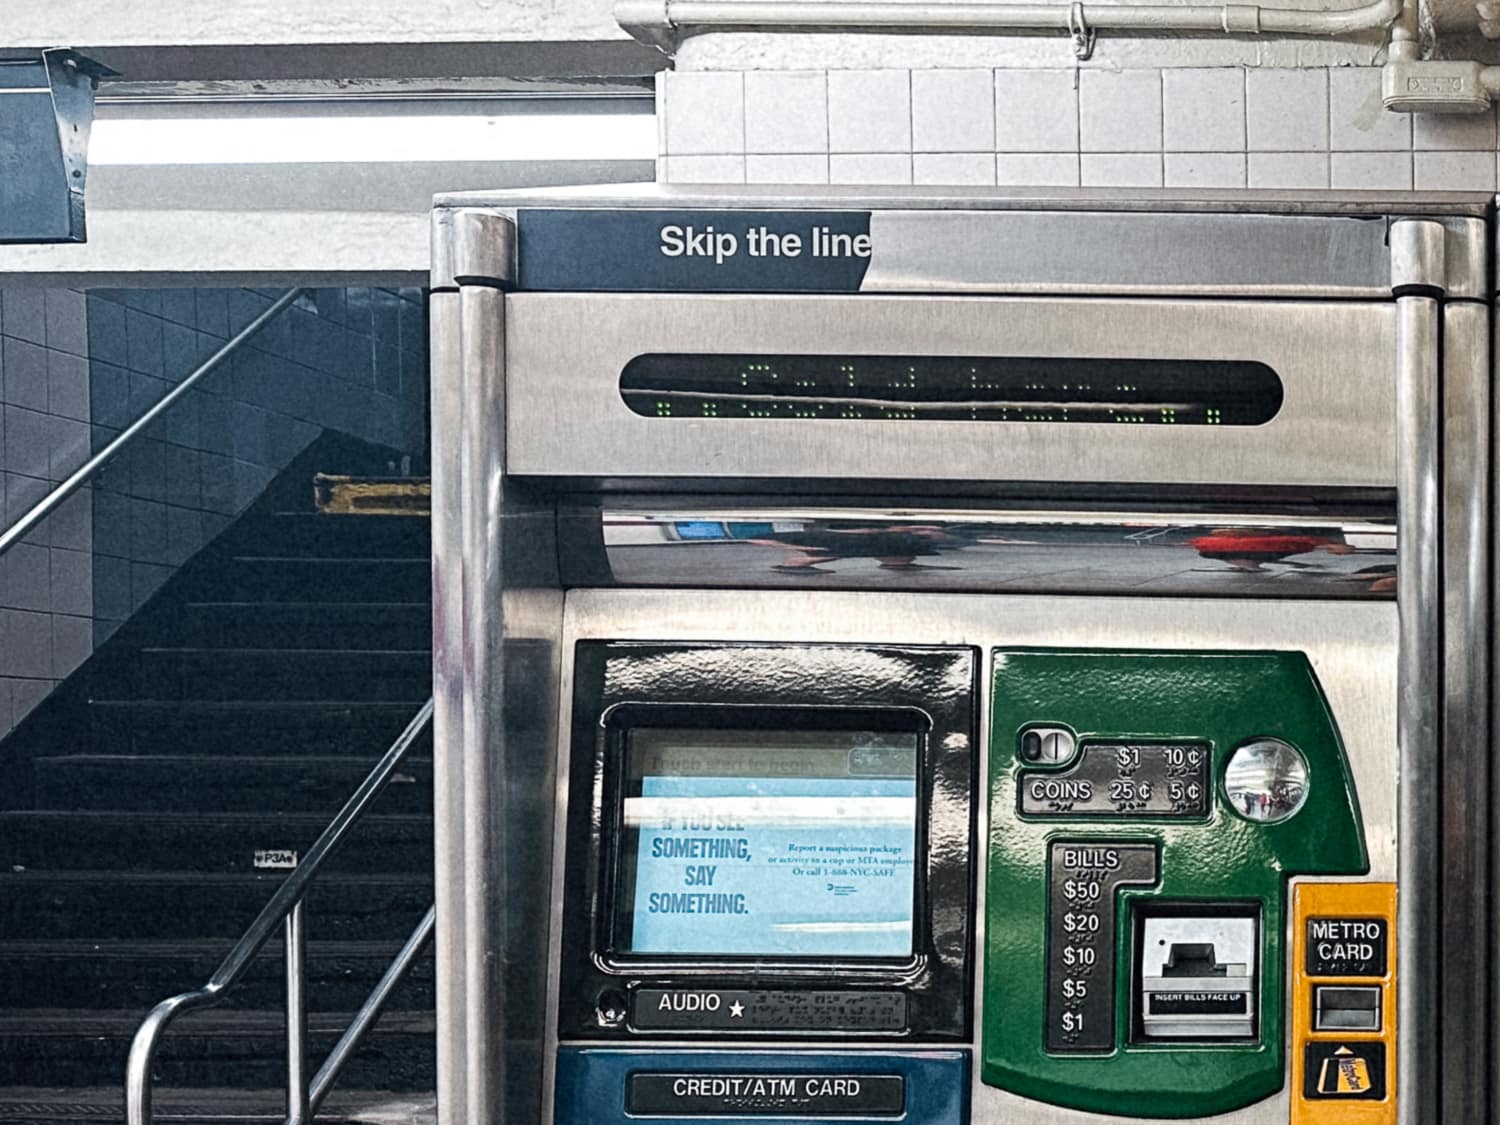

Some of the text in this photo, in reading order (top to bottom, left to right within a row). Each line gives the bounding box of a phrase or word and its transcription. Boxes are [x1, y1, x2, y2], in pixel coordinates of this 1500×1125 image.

[660, 225, 872, 264] Skip the line
[1118, 748, 1139, 767] $1
[1031, 782, 1092, 800] COINS
[652, 838, 752, 862] SOMETHING,
[788, 844, 817, 853] Report
[869, 844, 902, 854] package
[857, 856, 879, 864] MTA
[1064, 850, 1118, 867] BILLS
[685, 866, 716, 887] SAY
[792, 867, 804, 875] Or
[806, 867, 821, 876] call
[1064, 881, 1099, 900] $50
[649, 893, 749, 914] SOMETHING.
[1063, 914, 1099, 932] $20
[1312, 921, 1380, 940] METRO
[1063, 947, 1095, 965] $10
[1319, 943, 1373, 961] CARD
[1062, 979, 1086, 999] $5
[658, 994, 721, 1011] AUDIO
[1062, 1012, 1084, 1032] $1
[673, 1078, 860, 1096] CREDIT/ATM CARD
